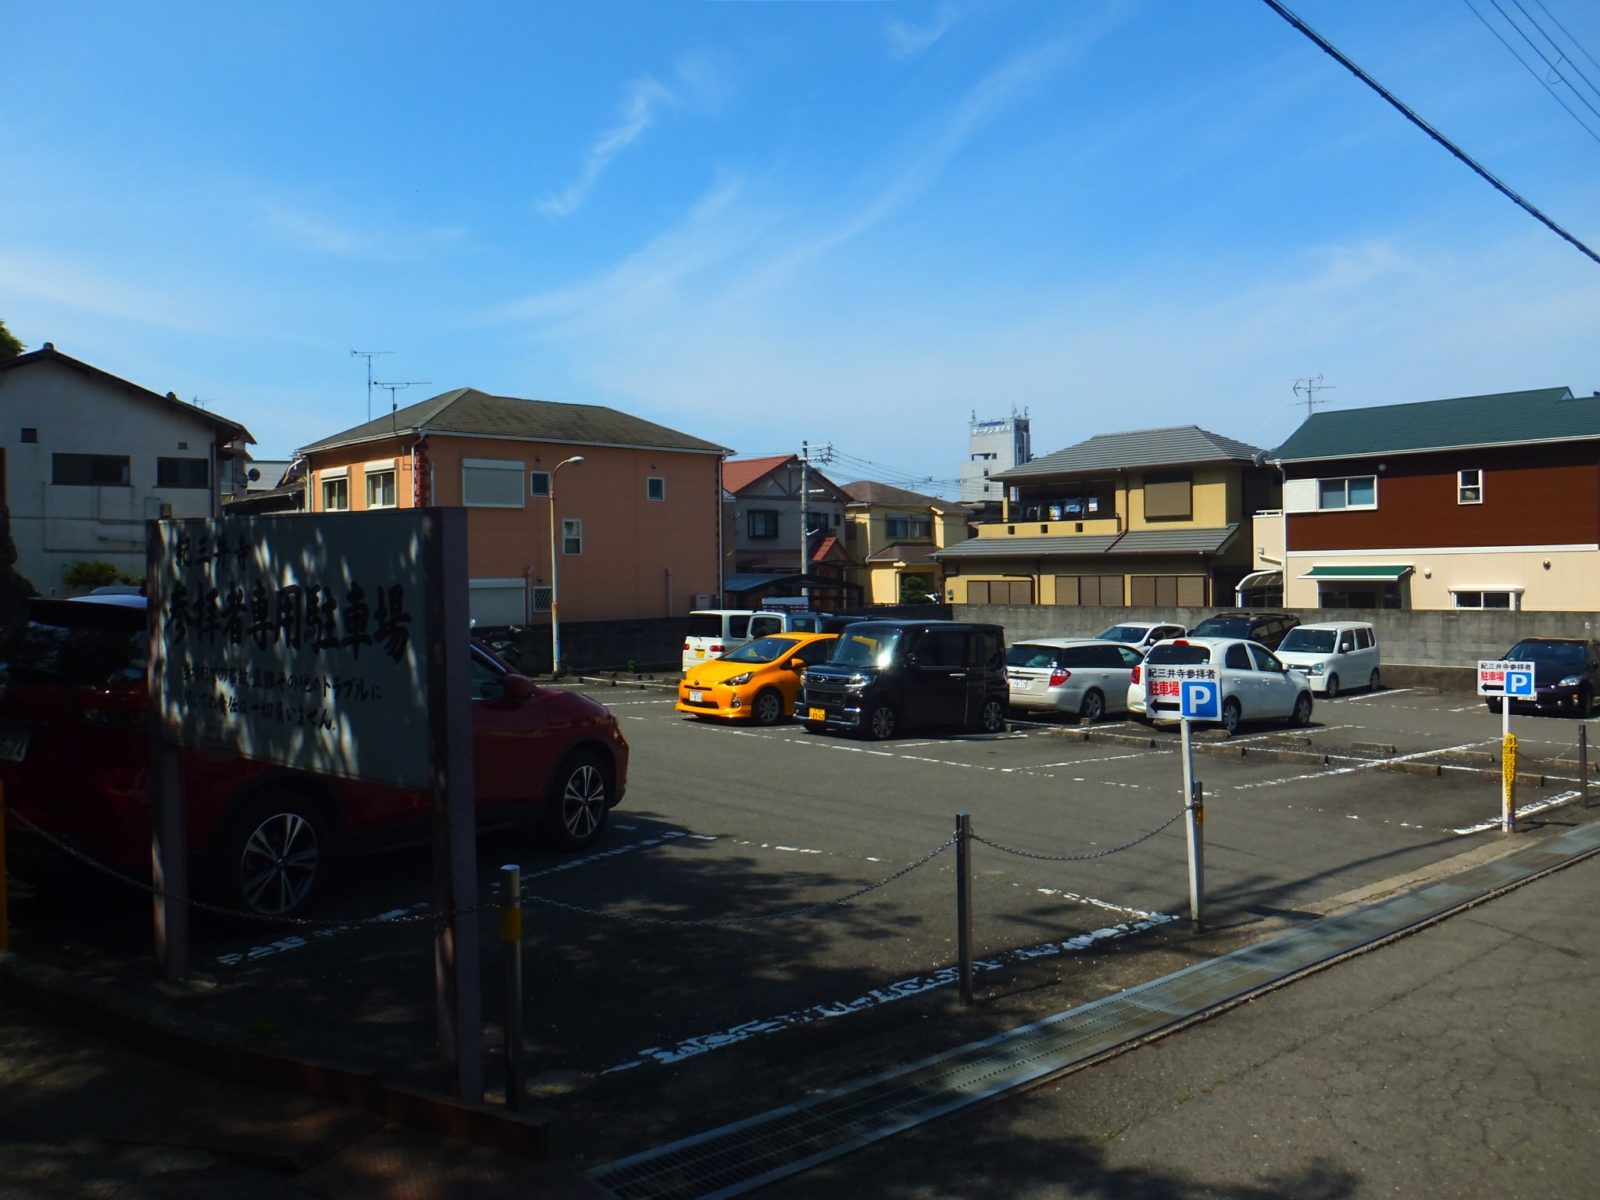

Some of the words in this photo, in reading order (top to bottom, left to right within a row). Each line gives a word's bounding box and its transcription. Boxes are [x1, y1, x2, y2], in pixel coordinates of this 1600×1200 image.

[167, 578, 412, 664] 参拝者専用駐車場
[1148, 668, 1216, 680] 紀三井寺参拝者
[1481, 663, 1532, 671] 紀三井寺参拝者
[1481, 671, 1504, 681] 駐車場
[1511, 674, 1527, 692] P
[1149, 681, 1180, 697] 駐車場
[1189, 685, 1211, 713] P
